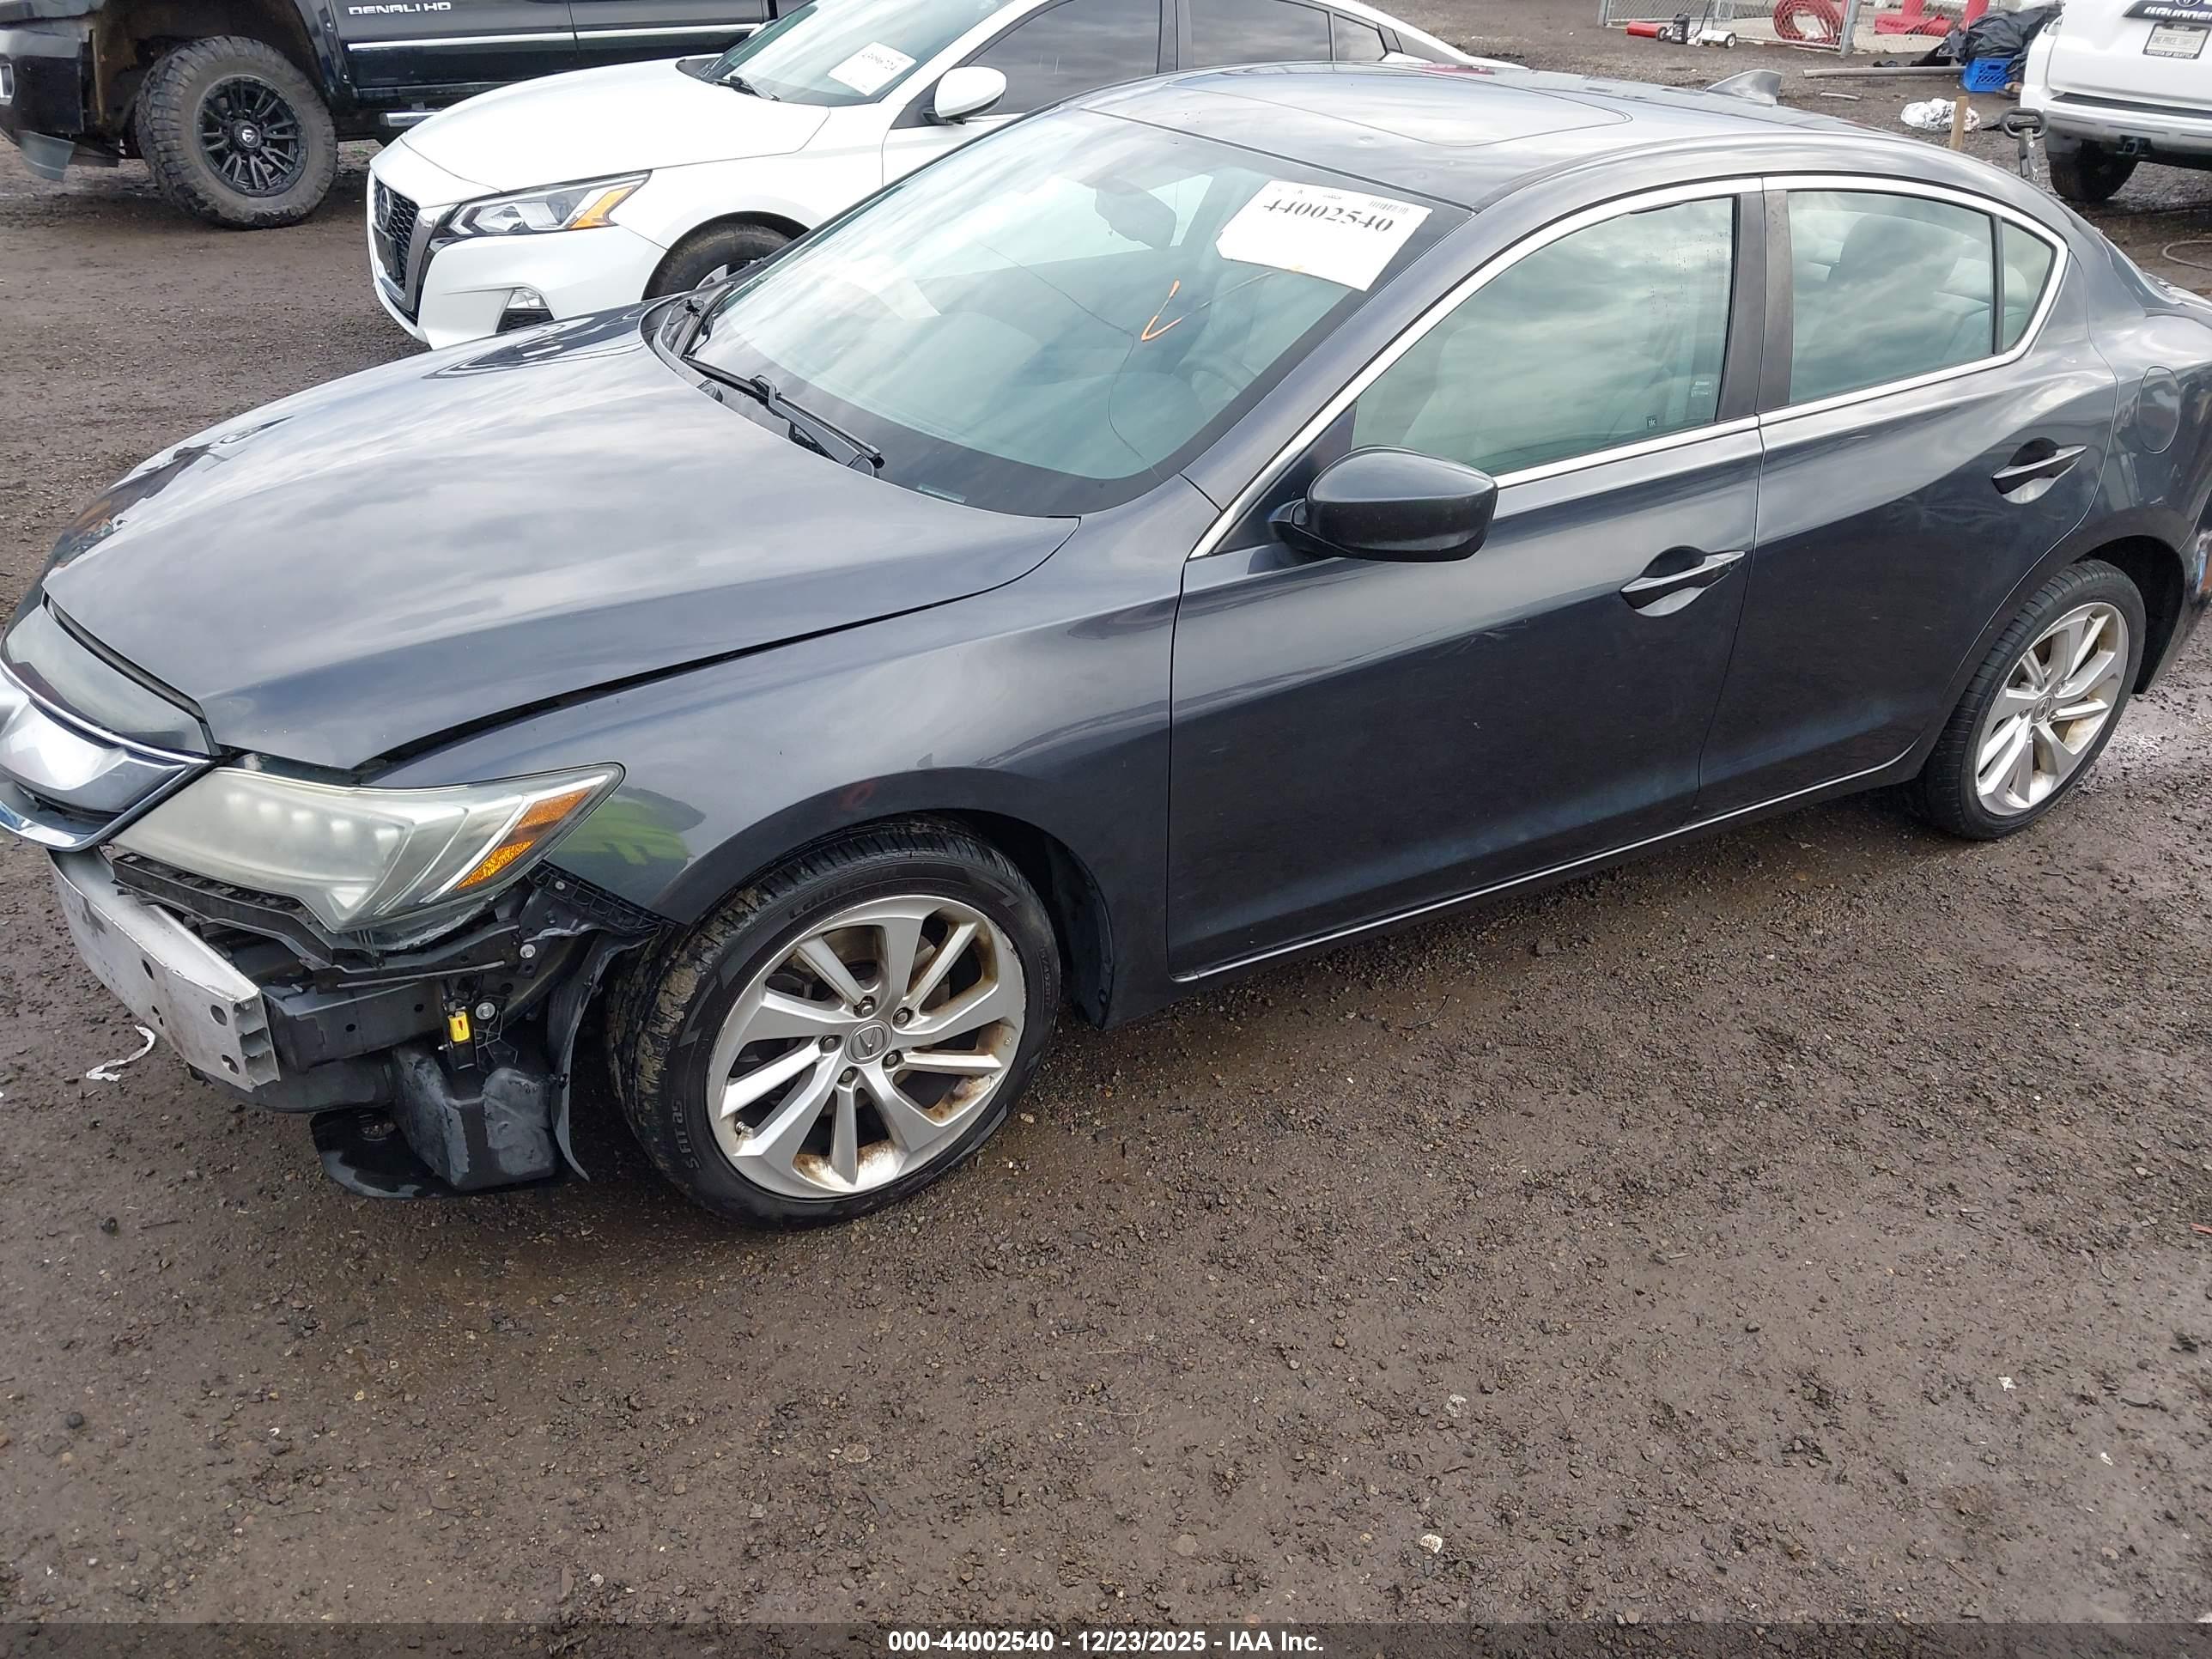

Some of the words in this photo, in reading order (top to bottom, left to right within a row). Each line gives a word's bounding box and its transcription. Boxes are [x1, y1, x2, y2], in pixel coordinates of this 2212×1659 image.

[348, 3, 421, 15] DENALI
[422, 2, 452, 12] HD
[1263, 198, 1395, 232] 44002540
